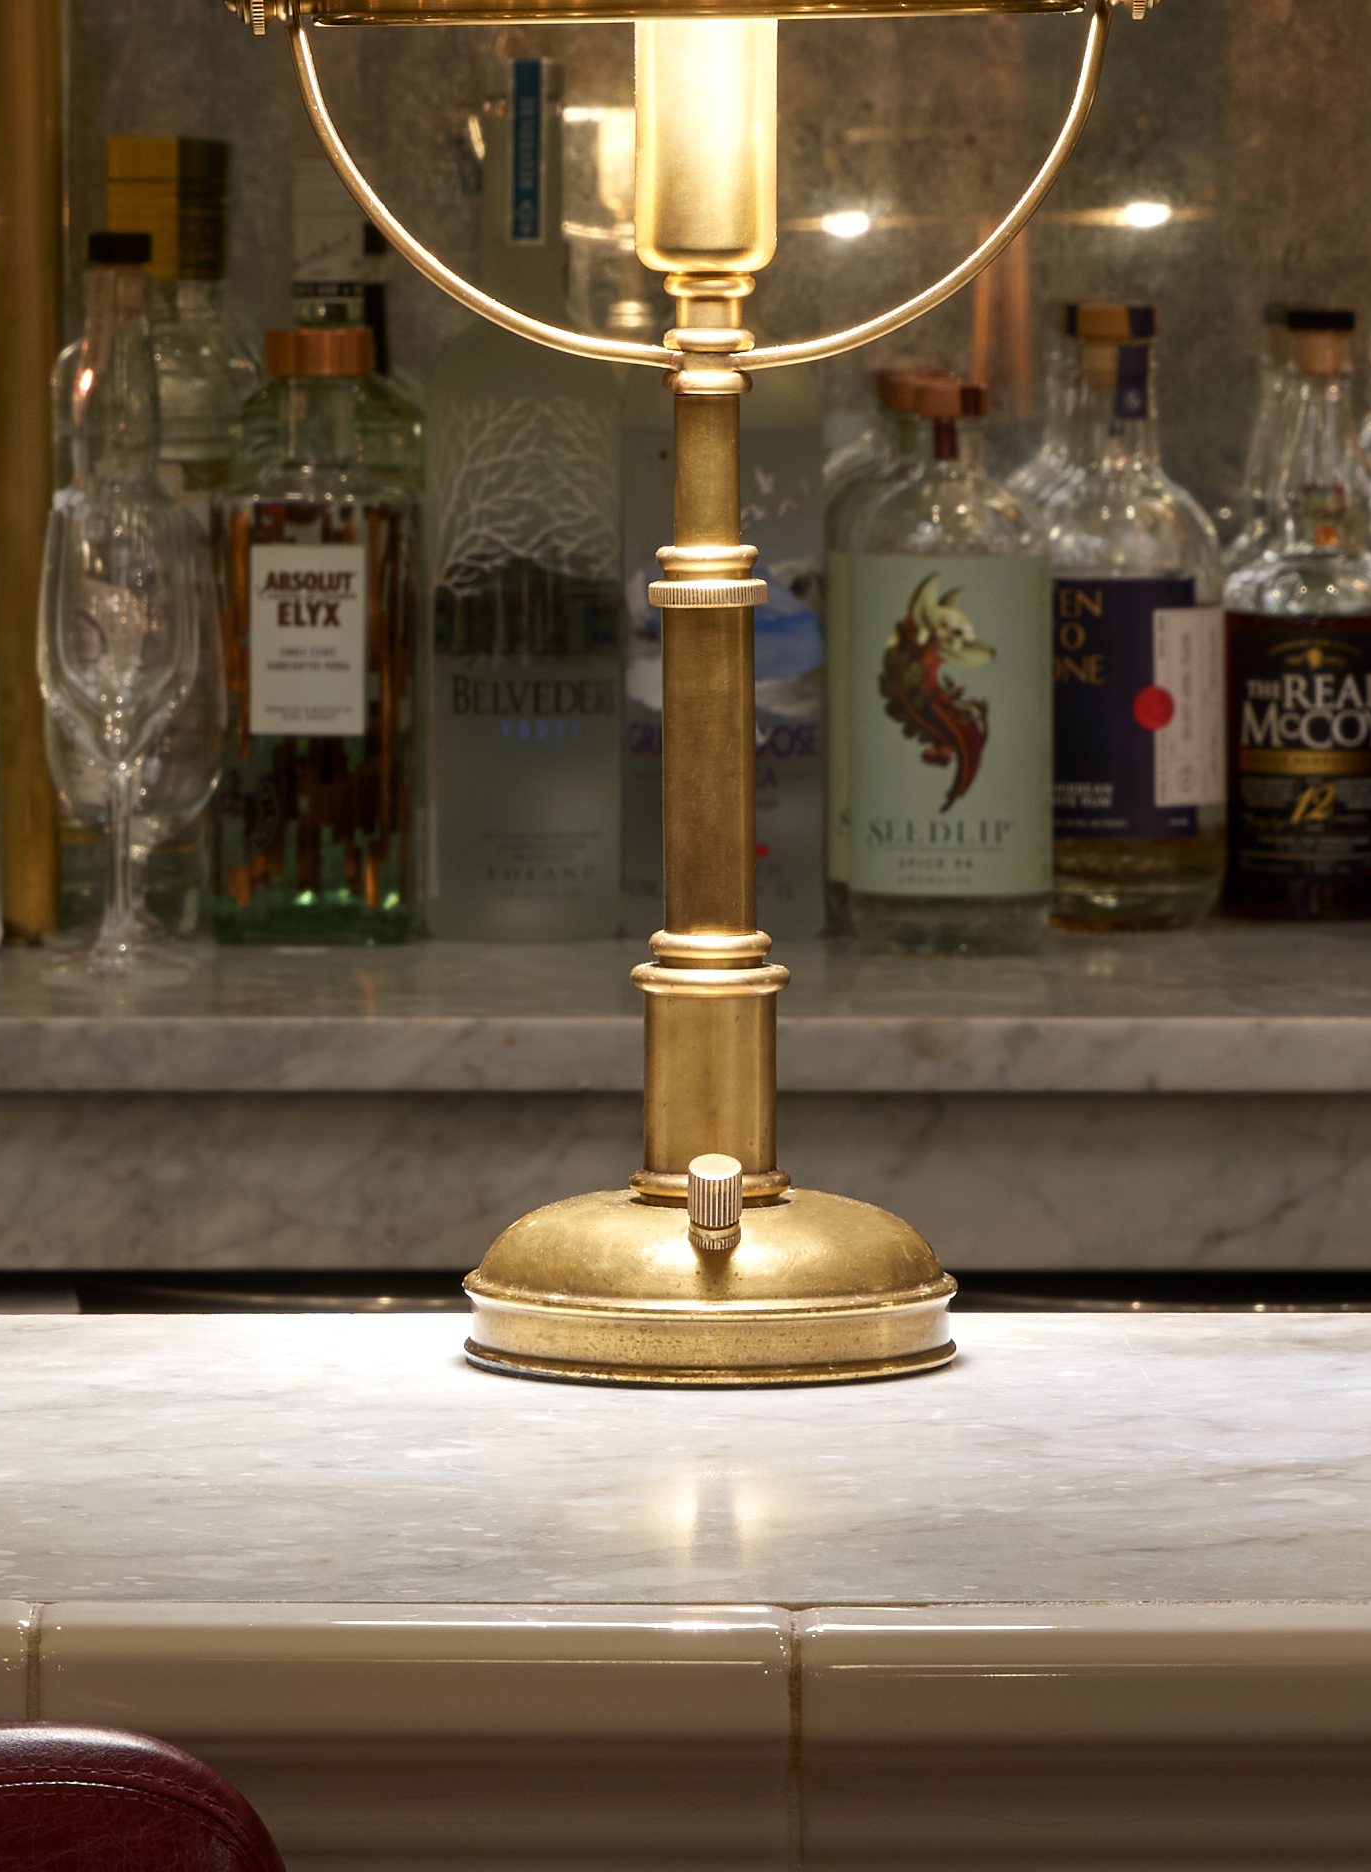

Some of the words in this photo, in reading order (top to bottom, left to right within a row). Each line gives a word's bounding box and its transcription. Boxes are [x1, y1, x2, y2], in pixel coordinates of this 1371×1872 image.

[265, 570, 354, 591] ABSOLUT
[278, 601, 342, 628] ELYX
[1055, 587, 1103, 619] EN
[1055, 621, 1087, 651] O
[1245, 679, 1281, 701] THE
[1290, 781, 1338, 826] 12
